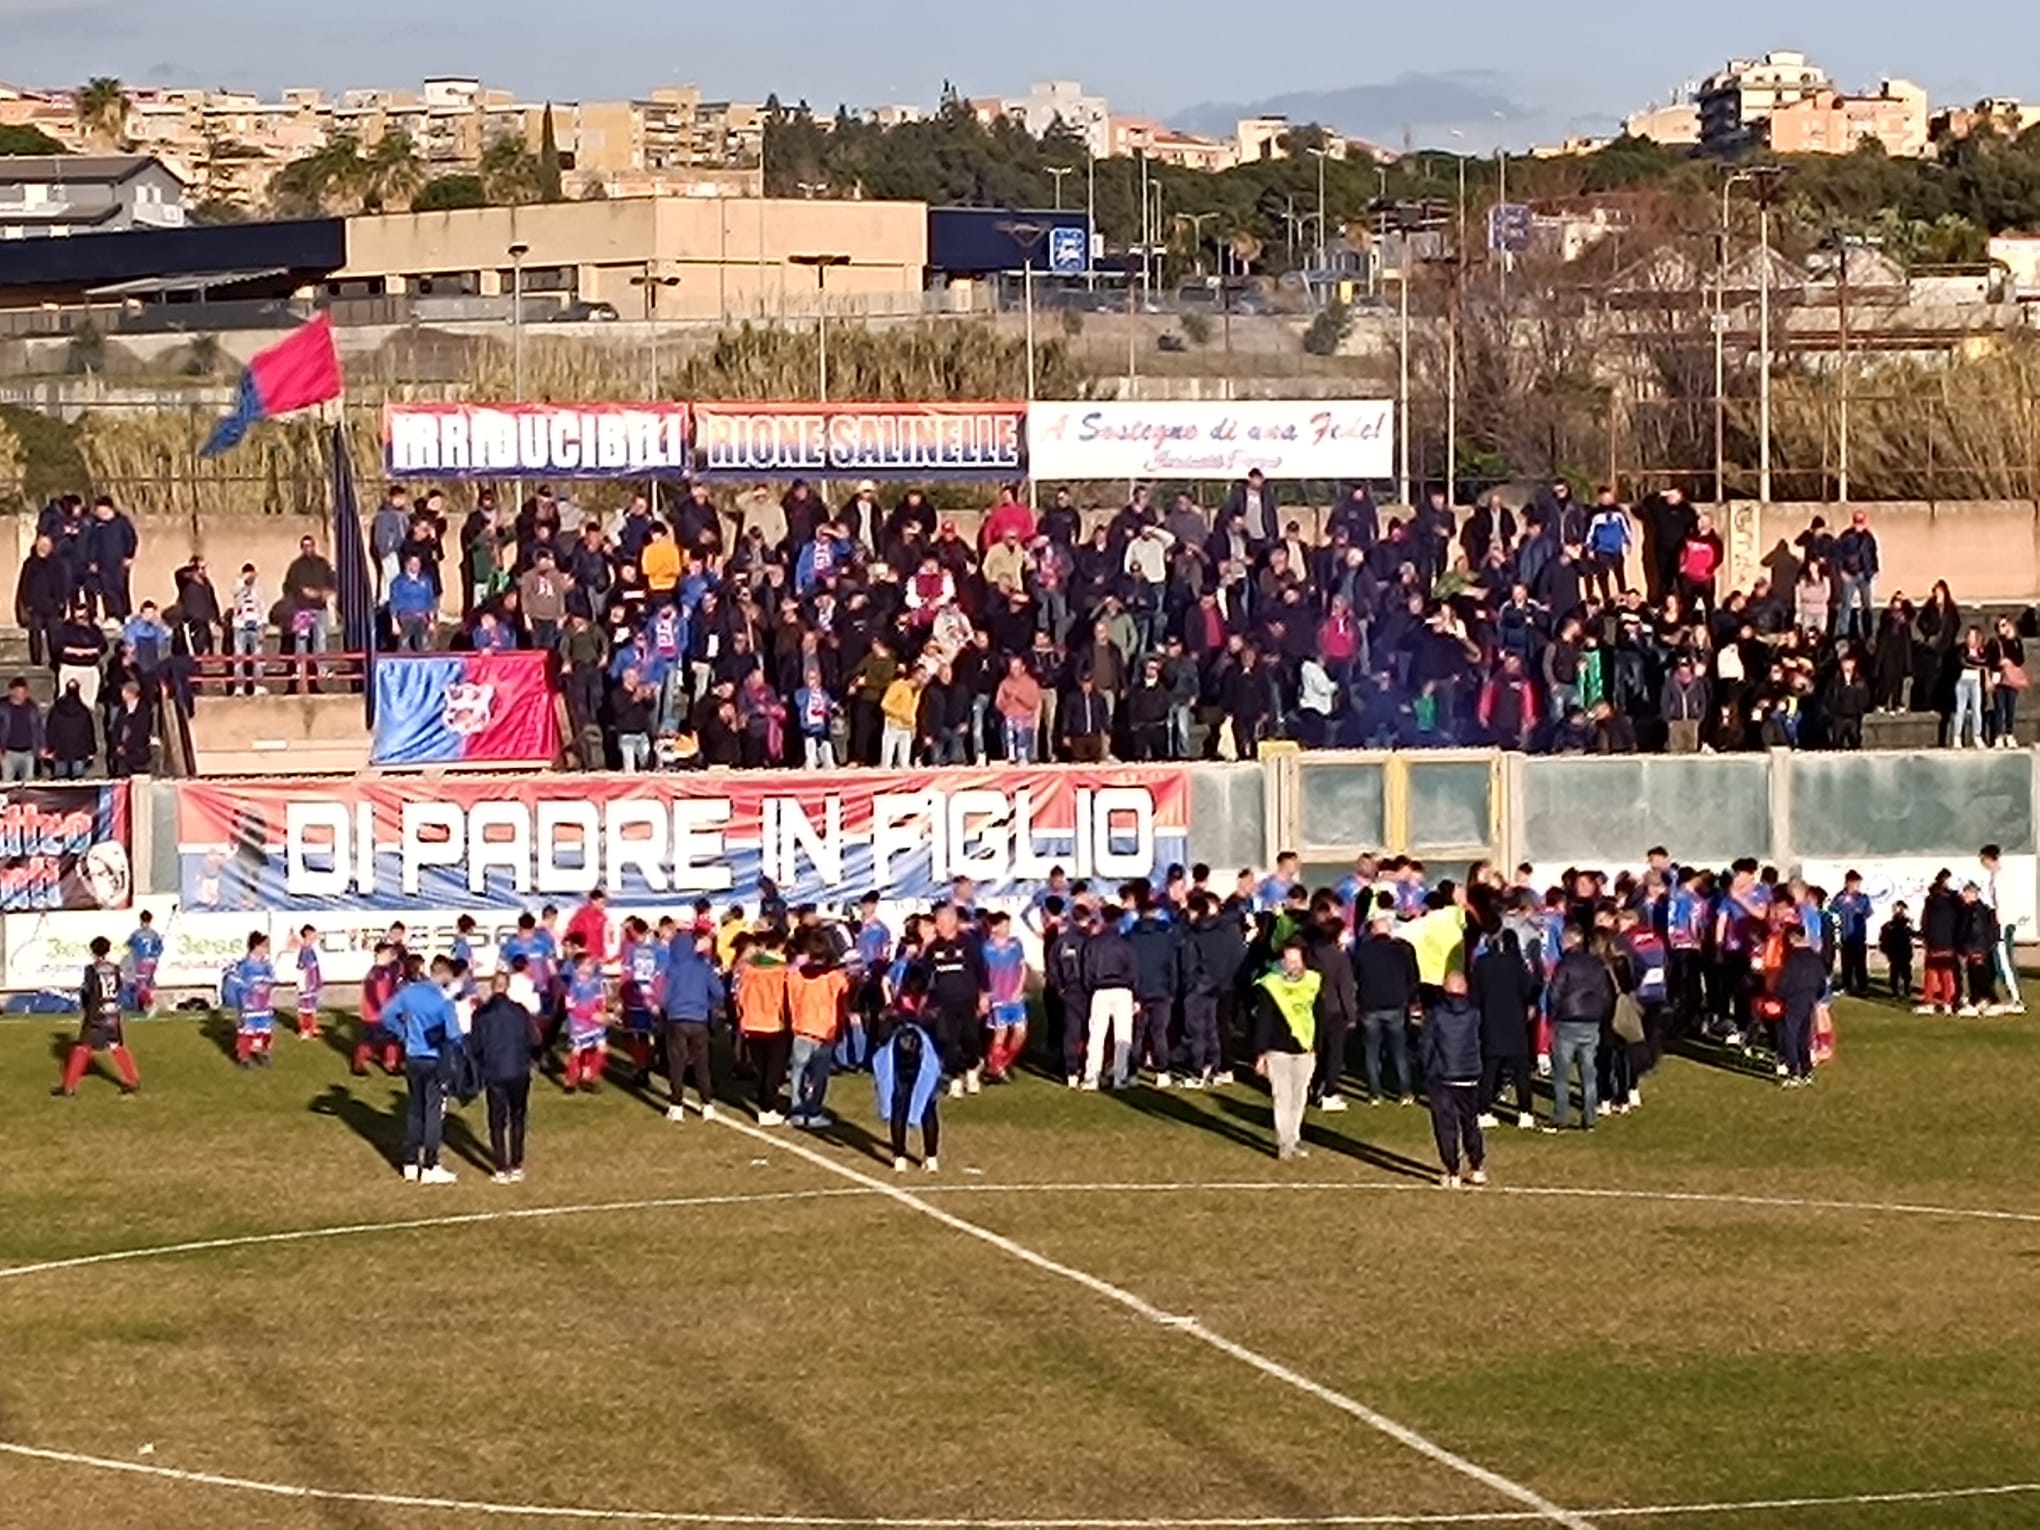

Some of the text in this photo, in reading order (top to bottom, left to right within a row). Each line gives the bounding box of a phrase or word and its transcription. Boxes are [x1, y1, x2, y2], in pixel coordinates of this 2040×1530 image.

[707, 413, 1018, 468] RIONE SALINELLE
[1209, 416, 1238, 442] di
[285, 785, 1156, 897] DI PADRE IN FIGLIO
